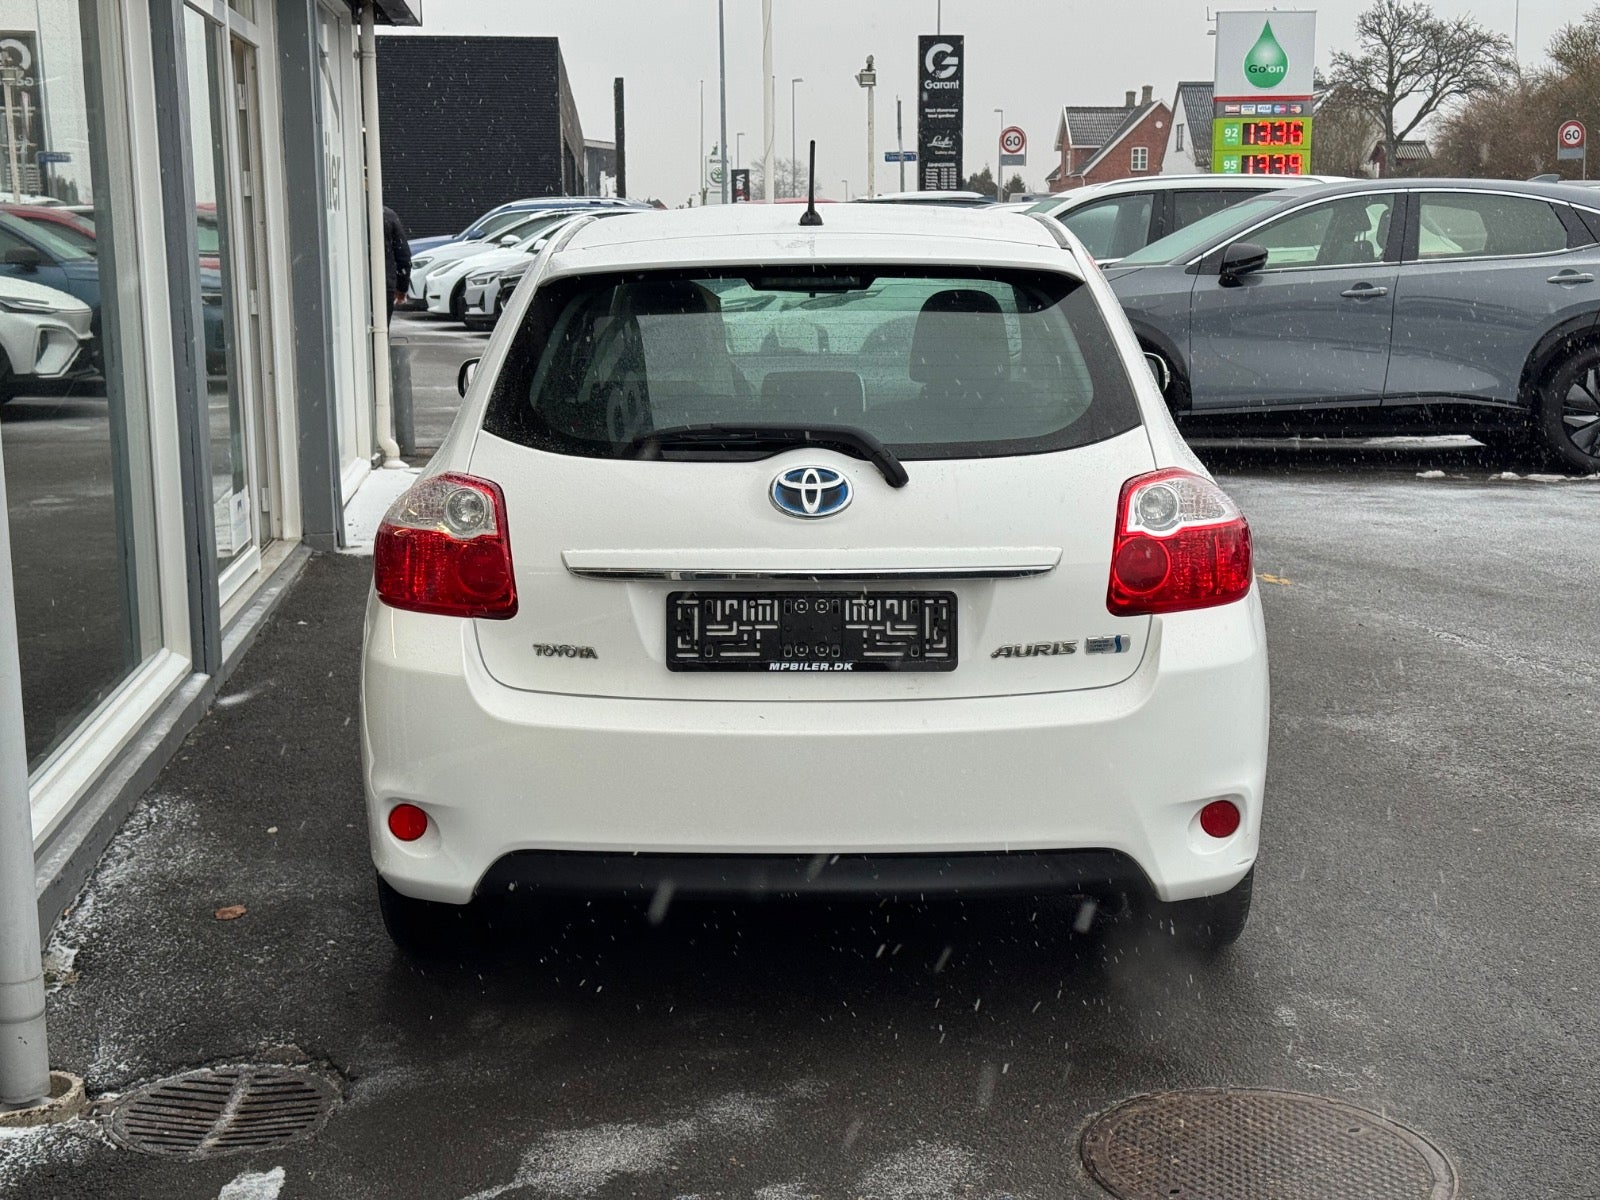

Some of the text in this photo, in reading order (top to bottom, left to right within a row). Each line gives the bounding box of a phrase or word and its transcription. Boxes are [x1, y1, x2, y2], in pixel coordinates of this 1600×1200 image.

[1248, 64, 1284, 73] Go'on
[924, 79, 960, 90] Garant
[1224, 121, 1303, 146] 92 13.36
[1565, 130, 1580, 140] 60
[1005, 136, 1021, 146] 60
[1223, 160, 1238, 170] 95
[325, 132, 340, 211] iler
[532, 643, 599, 660] TOYOTA
[991, 641, 1078, 659] AURIS
[768, 662, 854, 672] MPBILER.DK
